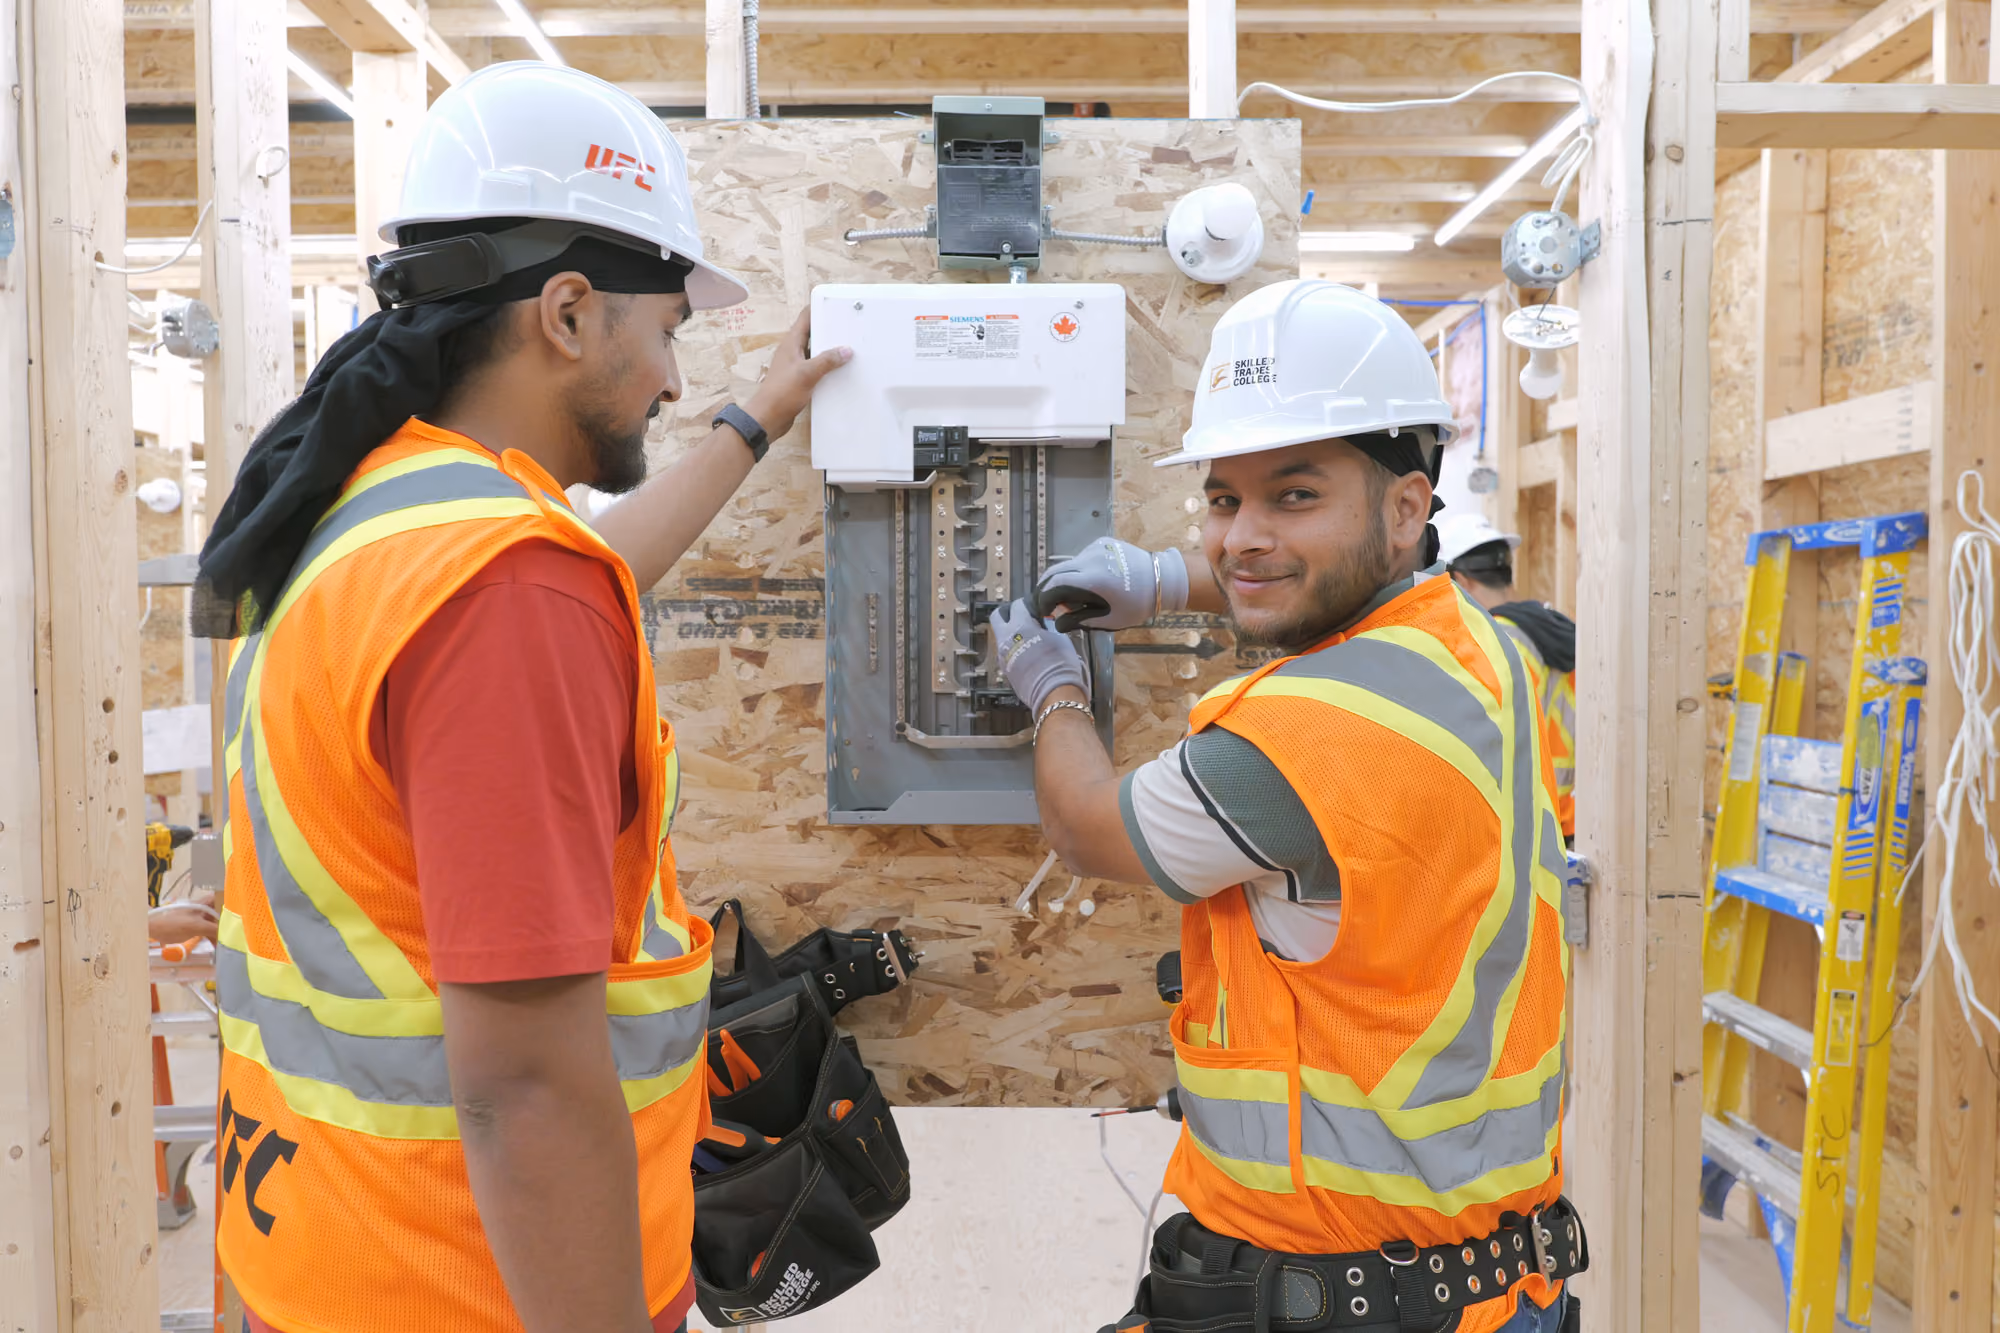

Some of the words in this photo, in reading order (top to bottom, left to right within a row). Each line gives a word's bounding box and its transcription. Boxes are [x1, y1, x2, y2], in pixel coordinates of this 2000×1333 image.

[585, 143, 655, 192] UFC
[1233, 374, 1277, 387] COLLEGE
[221, 1088, 299, 1237] FC
[1816, 1105, 1847, 1198] STC
[759, 1262, 799, 1311] SKILLED
[767, 1270, 805, 1312] TRADES
[769, 1268, 814, 1316] COLLEGE
